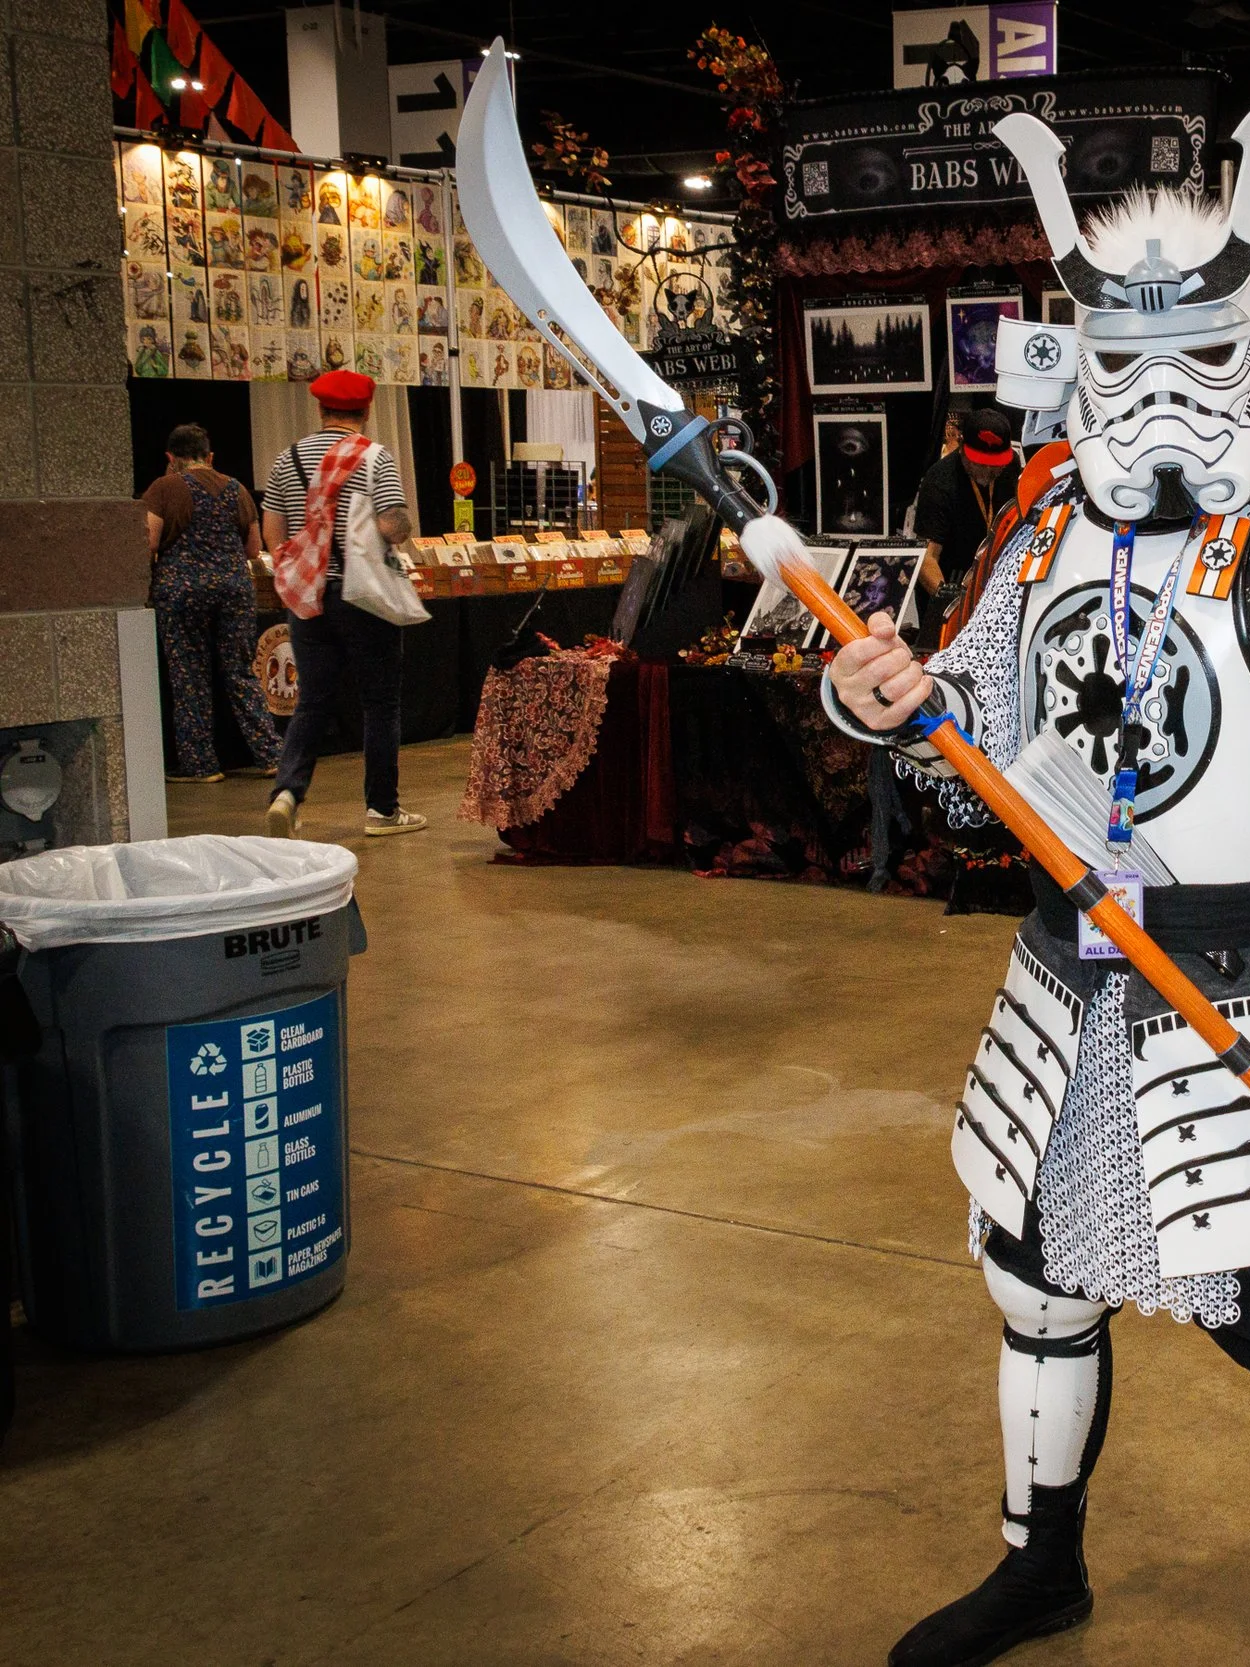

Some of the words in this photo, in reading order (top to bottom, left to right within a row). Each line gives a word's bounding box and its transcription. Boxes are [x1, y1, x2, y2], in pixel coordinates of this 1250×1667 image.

[997, 18, 1047, 78] AI
[944, 123, 971, 138] THE
[978, 121, 996, 135] AR
[909, 159, 979, 191] BABS
[667, 347, 682, 355] THE
[685, 344, 700, 352] ART
[702, 342, 712, 351] OF
[654, 358, 688, 377] ABS
[1112, 546, 1129, 610] DENVER
[1153, 575, 1176, 620] EXPO
[1113, 610, 1127, 652] EXPO
[1133, 619, 1165, 691] DENVER
[224, 917, 324, 959] BRUTE
[1085, 946, 1105, 956] ALL
[1108, 946, 1123, 955] DA
[280, 1023, 305, 1040] CLEAN
[280, 1027, 324, 1052] CARDBOARD
[282, 1058, 313, 1077] PLASTIC
[283, 1069, 315, 1090] BOTTLES
[284, 1103, 322, 1128] ALUMINUM
[284, 1136, 310, 1155] GLASS
[285, 1145, 316, 1167] BOTTLES
[191, 1091, 234, 1298] RECYCLE
[286, 1187, 300, 1202] TIN
[300, 1180, 320, 1198] CANS
[287, 1220, 317, 1240] PLASTIC
[288, 1245, 313, 1266] PAPER,
[288, 1249, 328, 1277] MAGAZINES
